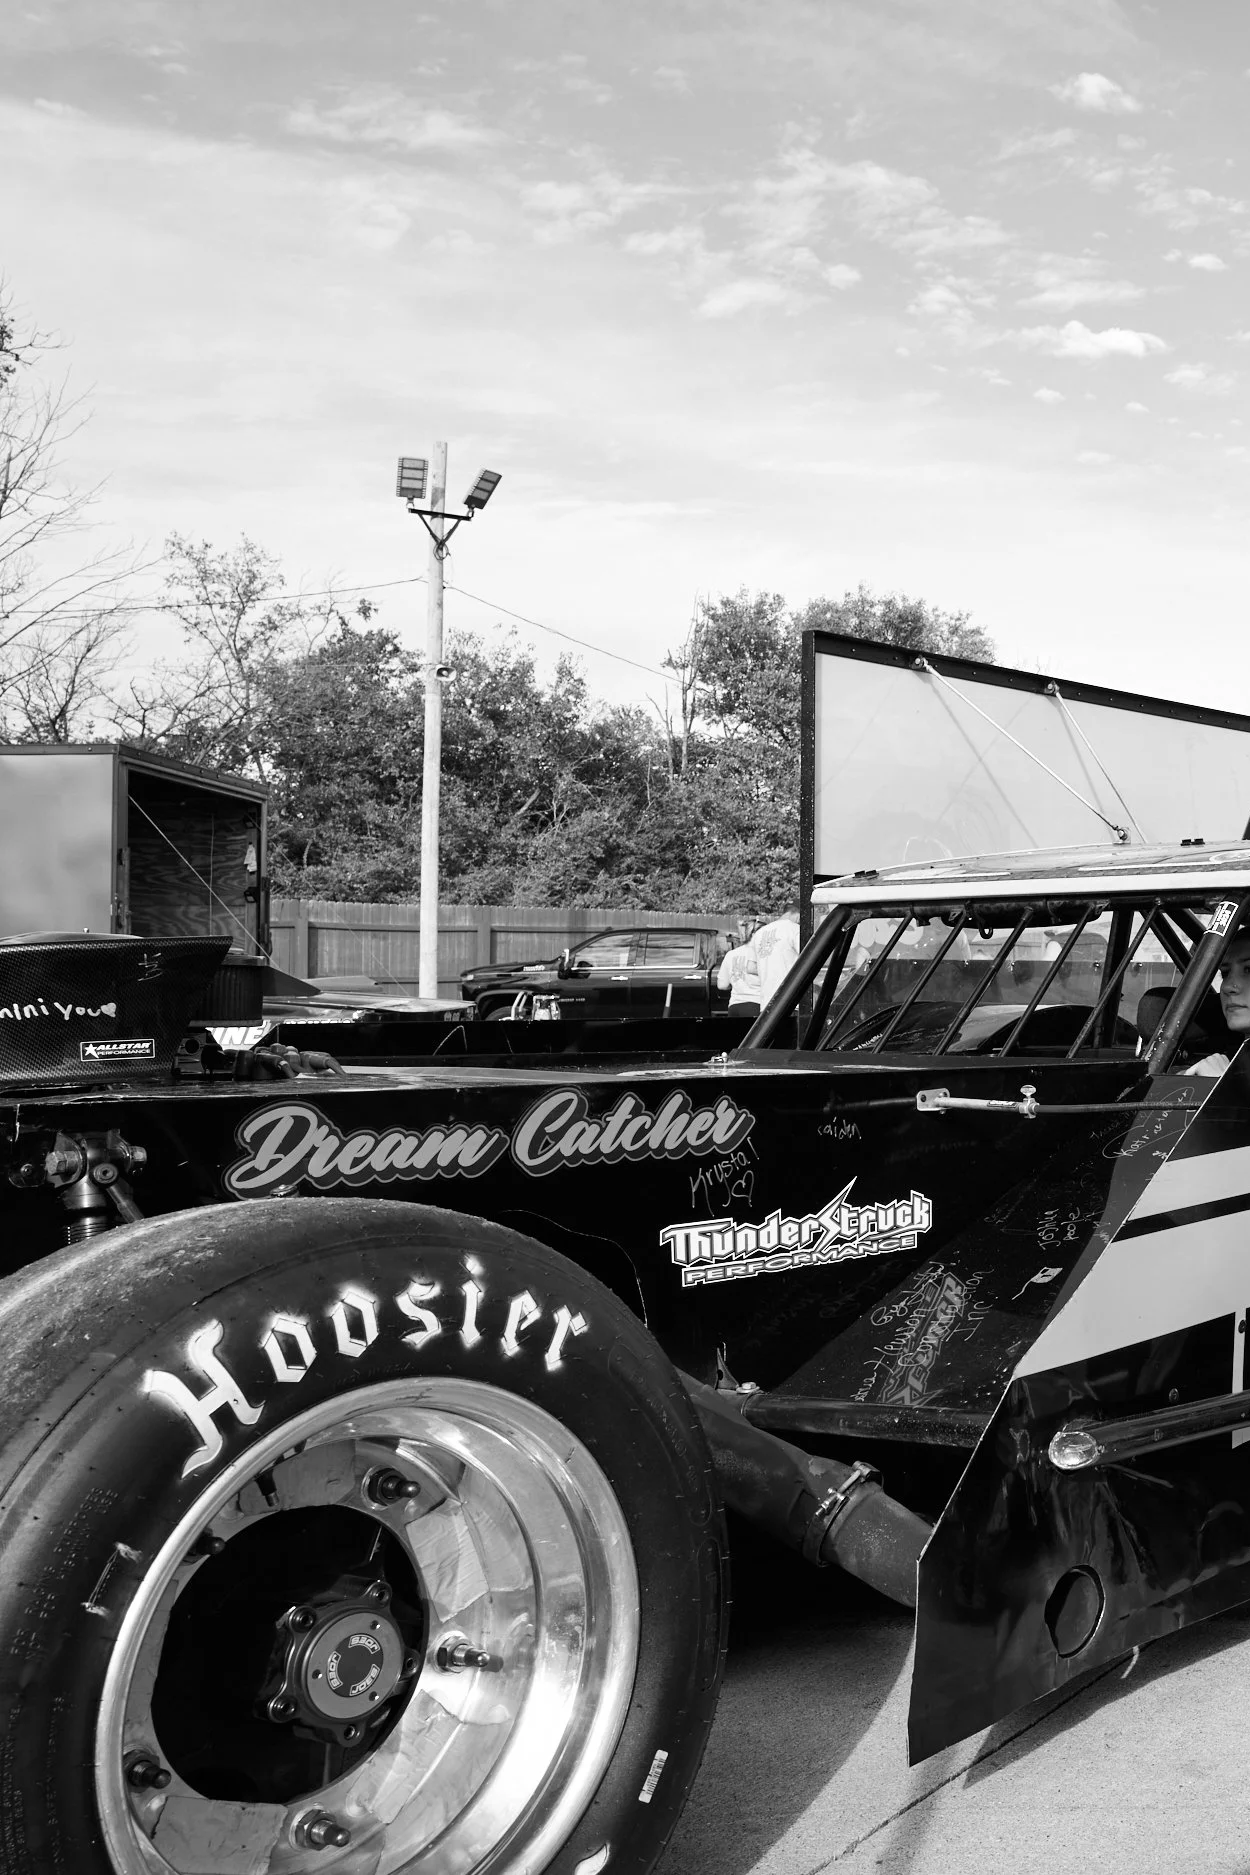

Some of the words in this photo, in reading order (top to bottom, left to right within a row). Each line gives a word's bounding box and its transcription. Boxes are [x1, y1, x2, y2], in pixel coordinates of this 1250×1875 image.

[96, 1042, 152, 1051] ALLSTAR
[96, 1048, 152, 1056] PERFORMANCE
[226, 1103, 504, 1194] Dream
[512, 1088, 753, 1173] Catcher
[682, 1231, 918, 1287] PERFORMANCE
[143, 1256, 588, 1479] Hoosier
